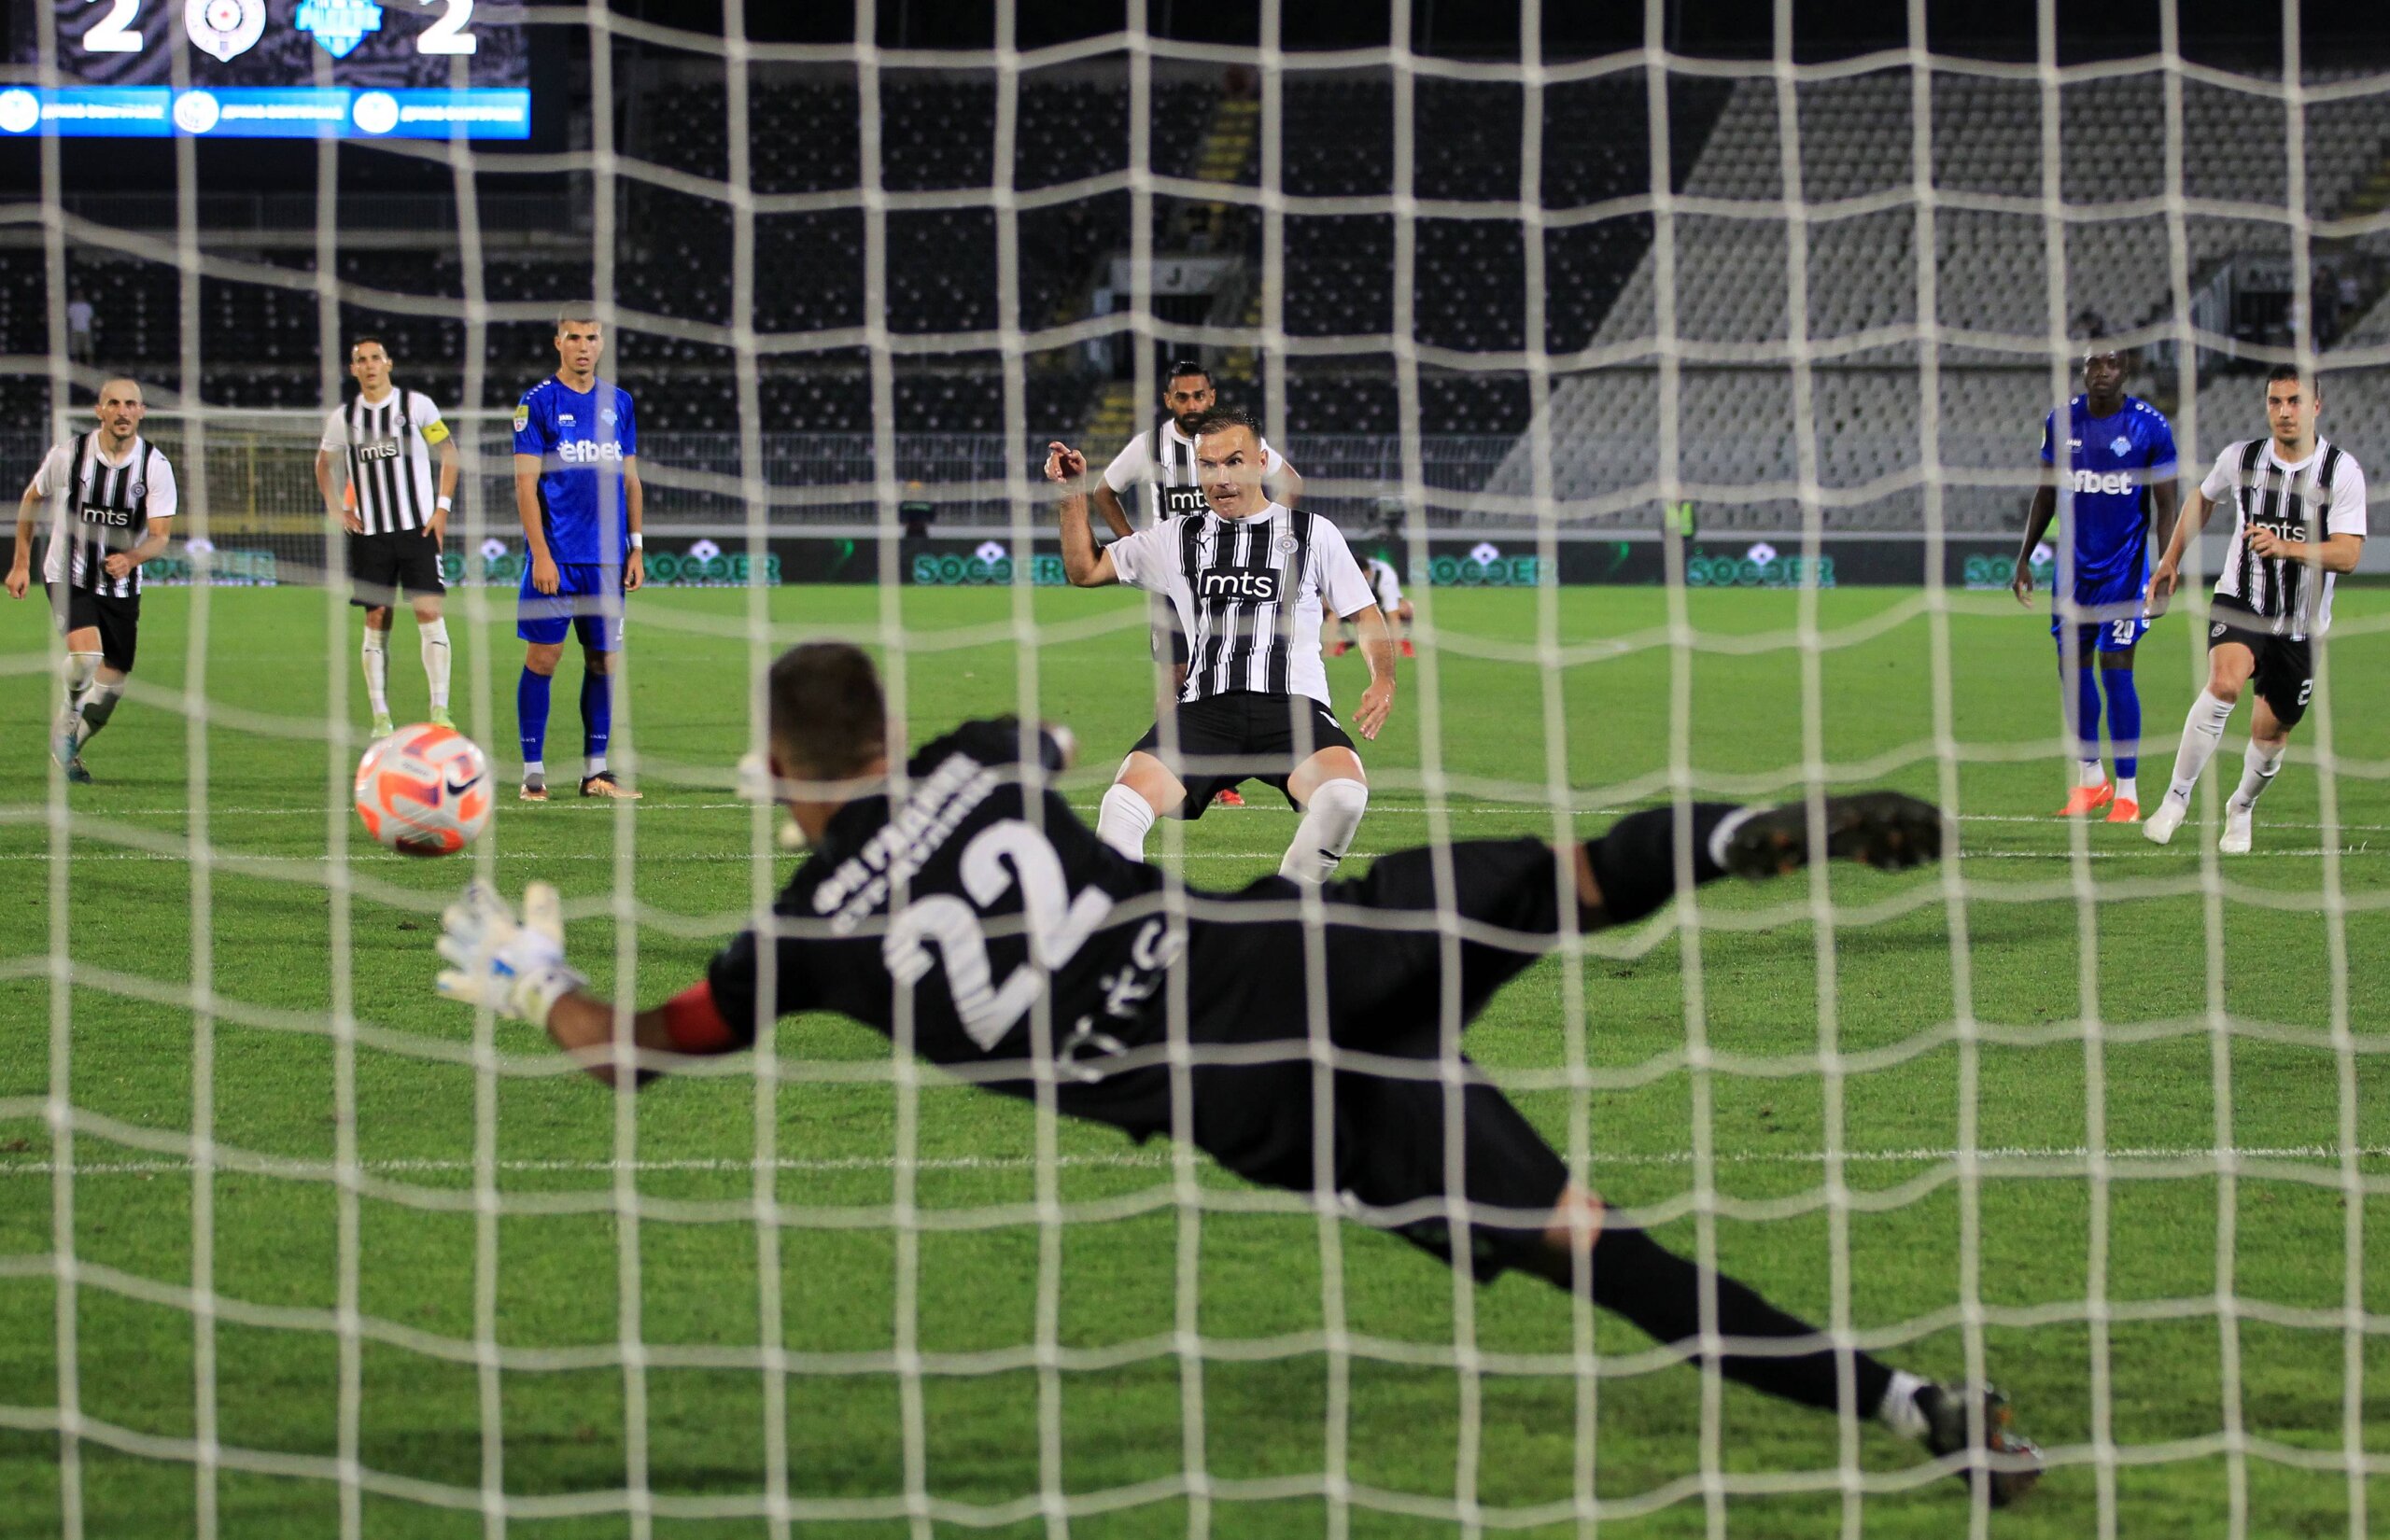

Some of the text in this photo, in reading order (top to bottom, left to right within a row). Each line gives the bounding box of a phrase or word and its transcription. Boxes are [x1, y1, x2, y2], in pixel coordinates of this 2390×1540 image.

[83, 0, 477, 54] 2 2
[360, 441, 398, 461] mts
[557, 439, 624, 463] efbet
[1171, 489, 1210, 509] mt
[83, 508, 129, 525] mts
[2256, 521, 2307, 543] mts
[1204, 571, 1273, 598] mts
[2112, 619, 2135, 638] 20
[883, 818, 1113, 1052] 22
